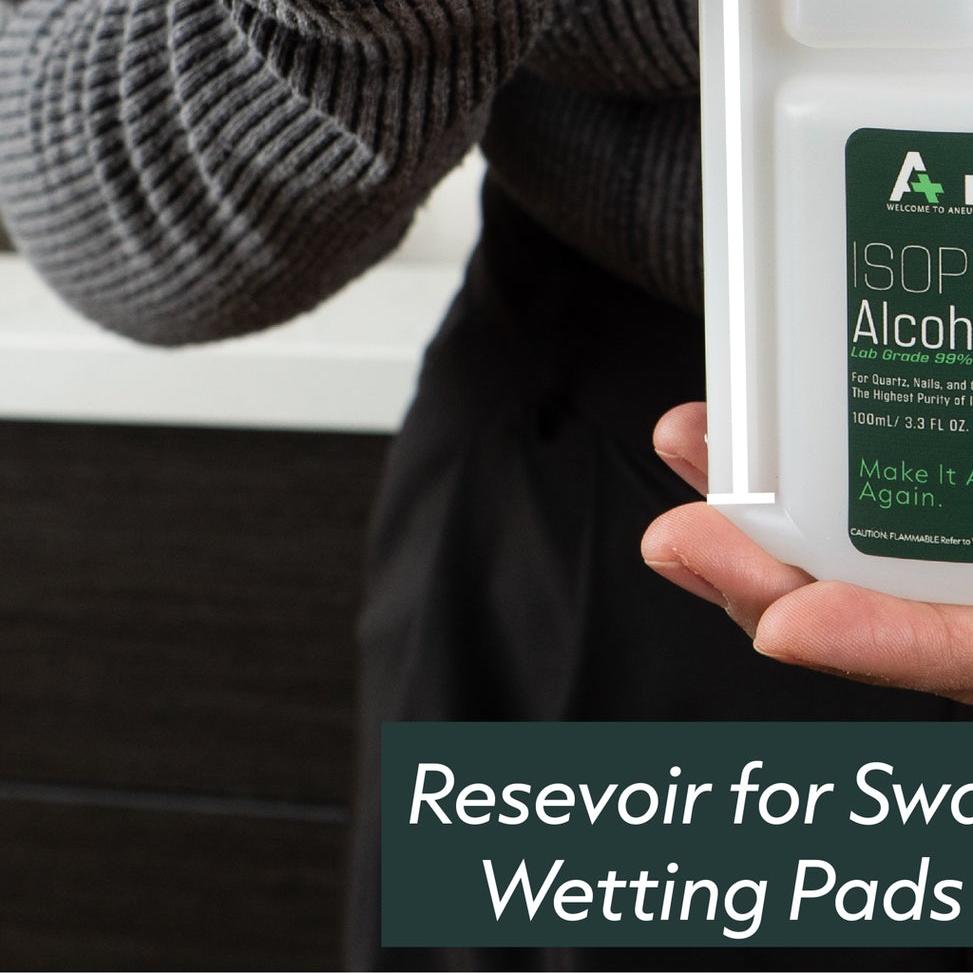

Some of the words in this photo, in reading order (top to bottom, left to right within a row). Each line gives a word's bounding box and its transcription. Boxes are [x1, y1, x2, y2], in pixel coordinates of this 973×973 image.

[887, 204, 930, 213] WELCOME
[933, 205, 945, 214] TO
[948, 207, 973, 215] ANEU
[851, 347, 877, 359] Lab
[882, 350, 930, 363] Grade
[935, 353, 973, 365] 99%
[852, 373, 868, 385] For
[872, 374, 910, 388] Quartz,
[914, 377, 943, 390] Nails,
[946, 378, 966, 391] and
[852, 388, 869, 400] The
[873, 390, 913, 403] Highest
[917, 393, 950, 406] Purity
[954, 394, 965, 406] of
[853, 412, 900, 428] 100mL/
[905, 417, 925, 430] 3.3
[930, 418, 944, 431] FL
[950, 419, 969, 432] OZ.
[860, 458, 929, 484] Make
[939, 464, 956, 485] It
[859, 481, 942, 509] Again.
[850, 528, 888, 539] CAUTION:
[890, 533, 939, 544] FLAMMABLE
[941, 536, 961, 545] Refer
